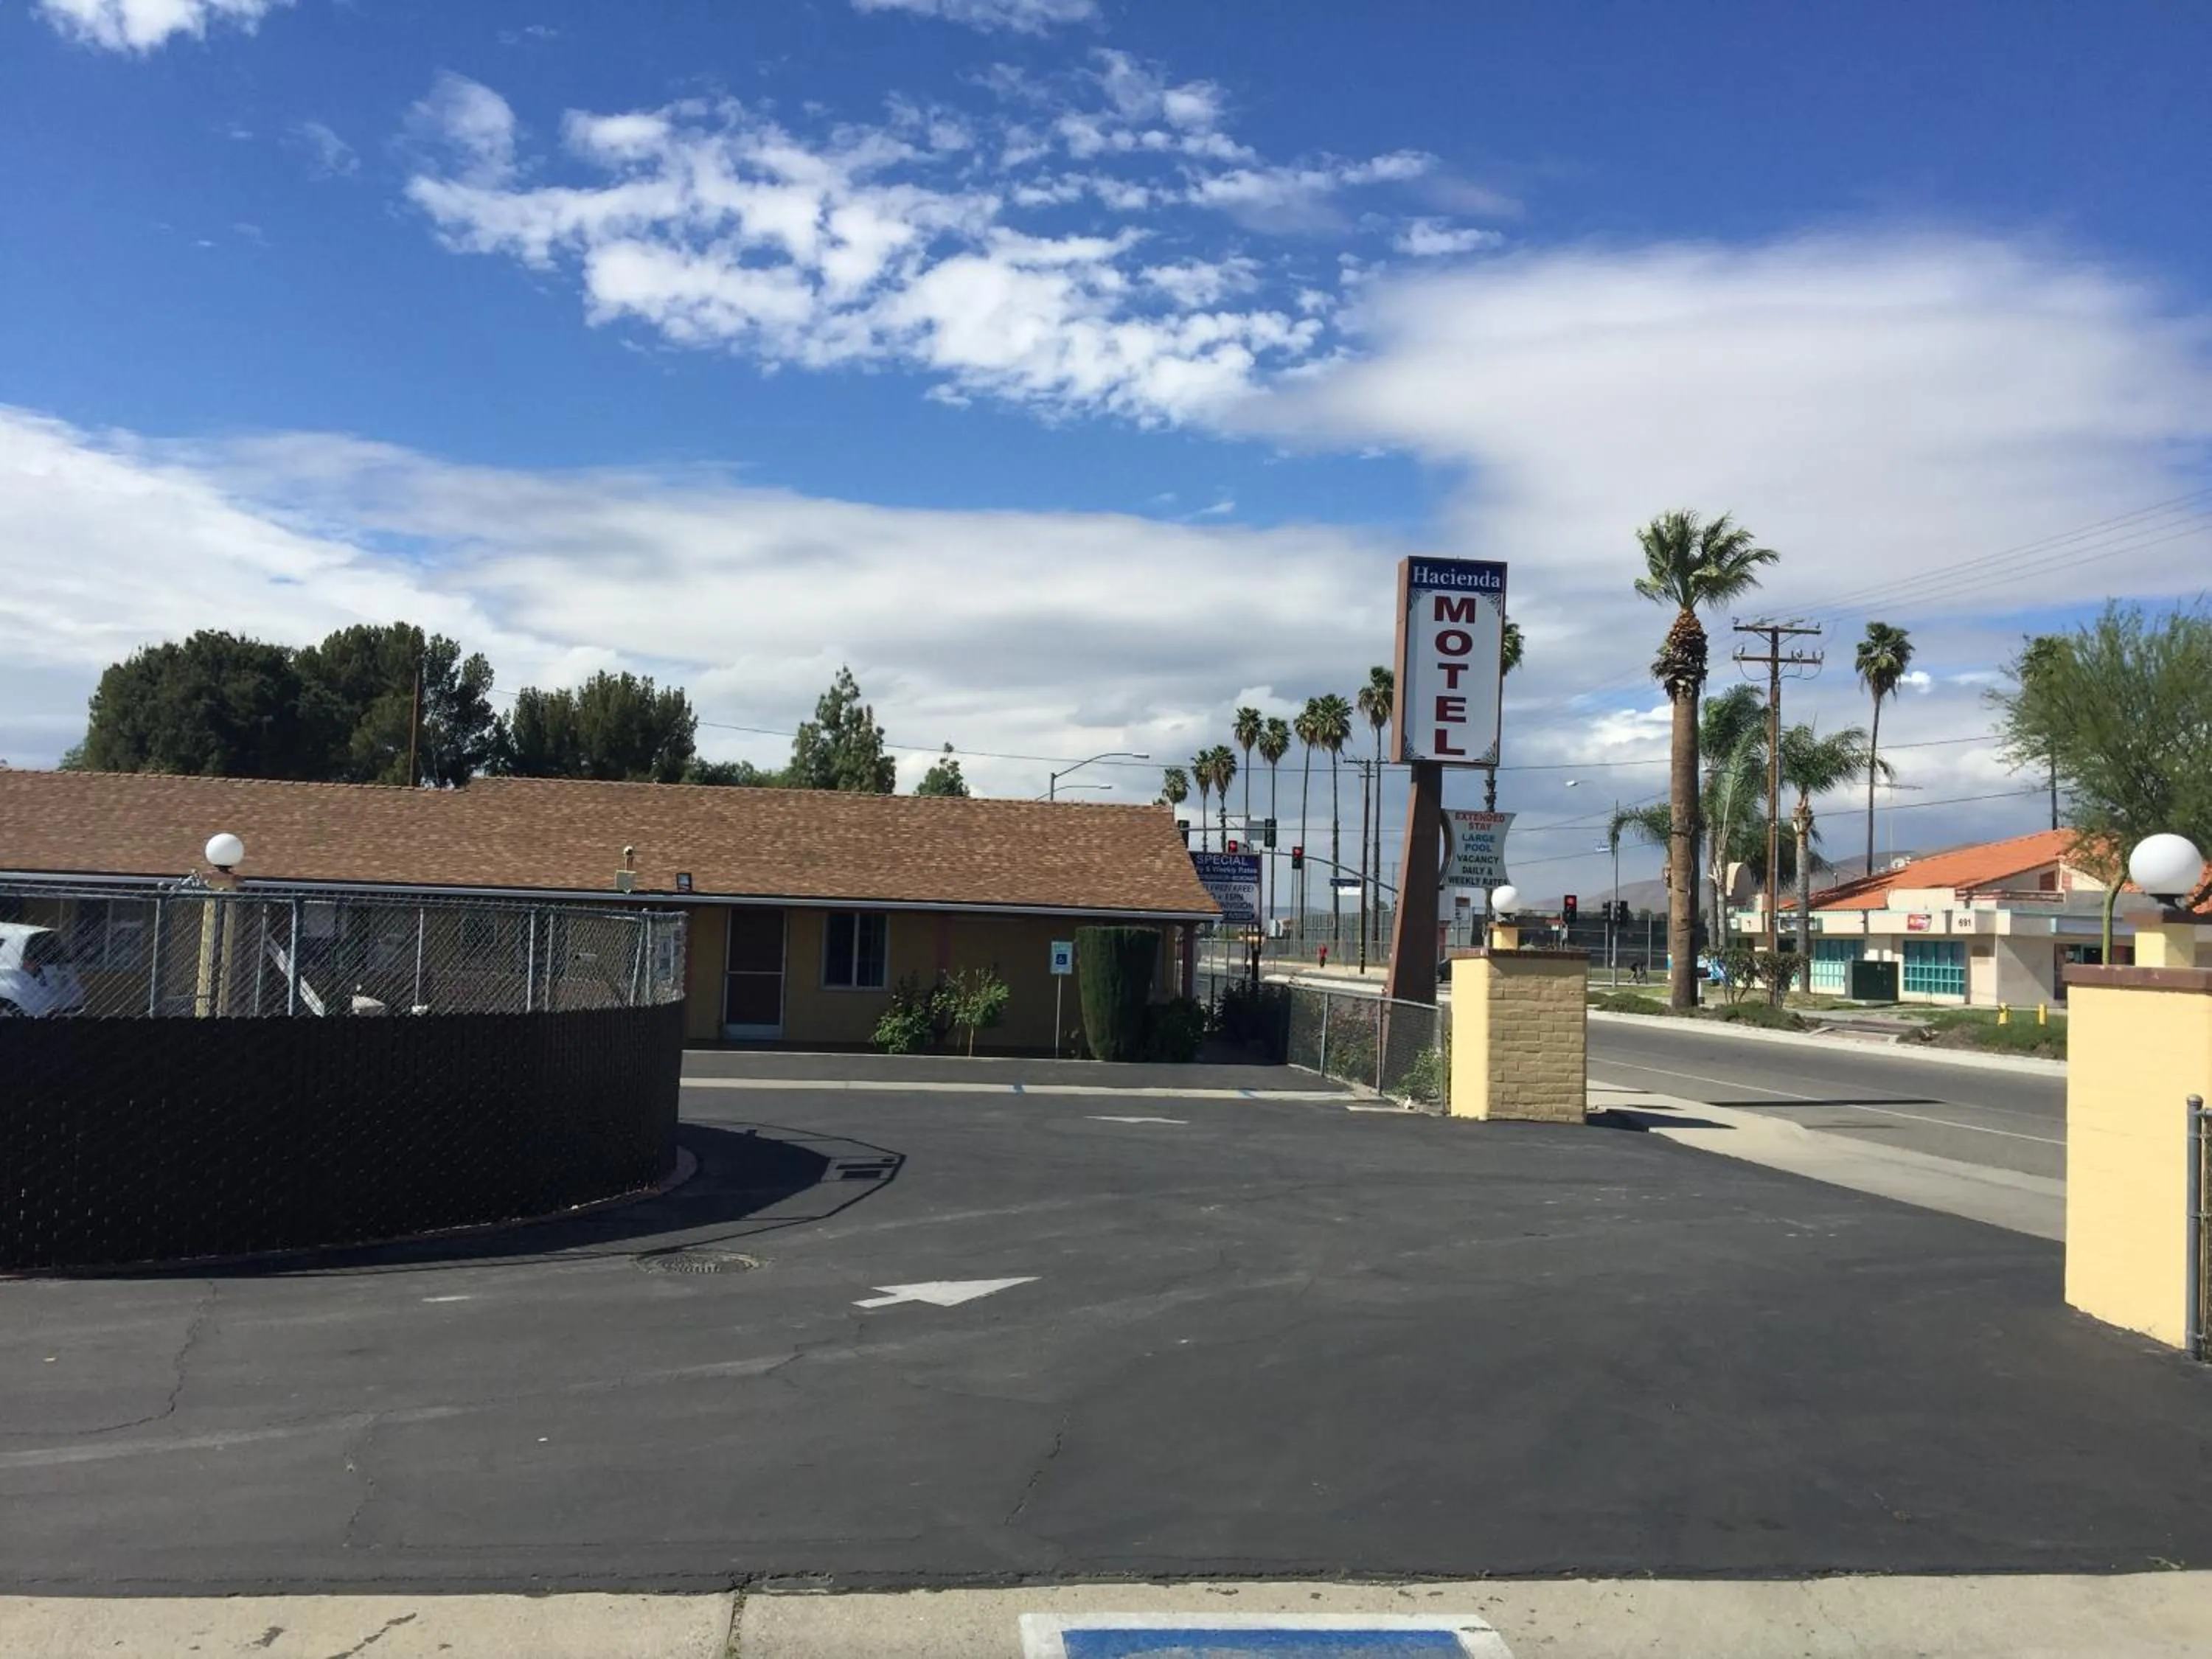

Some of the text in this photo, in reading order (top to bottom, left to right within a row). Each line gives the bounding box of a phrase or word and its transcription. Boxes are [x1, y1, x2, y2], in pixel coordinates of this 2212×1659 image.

[1413, 566, 1500, 588] Hacienda
[1434, 596, 1475, 755] MOTEL
[1455, 813, 1505, 822] EXTENDED
[1462, 834, 1495, 842] LARGE
[1465, 844, 1492, 852] POOL
[1197, 855, 1248, 865] SPECIAL
[1457, 854, 1500, 864] VACANCY
[1463, 866, 1484, 874] DAILY
[1448, 876, 1508, 886] WEEKLY RATES
